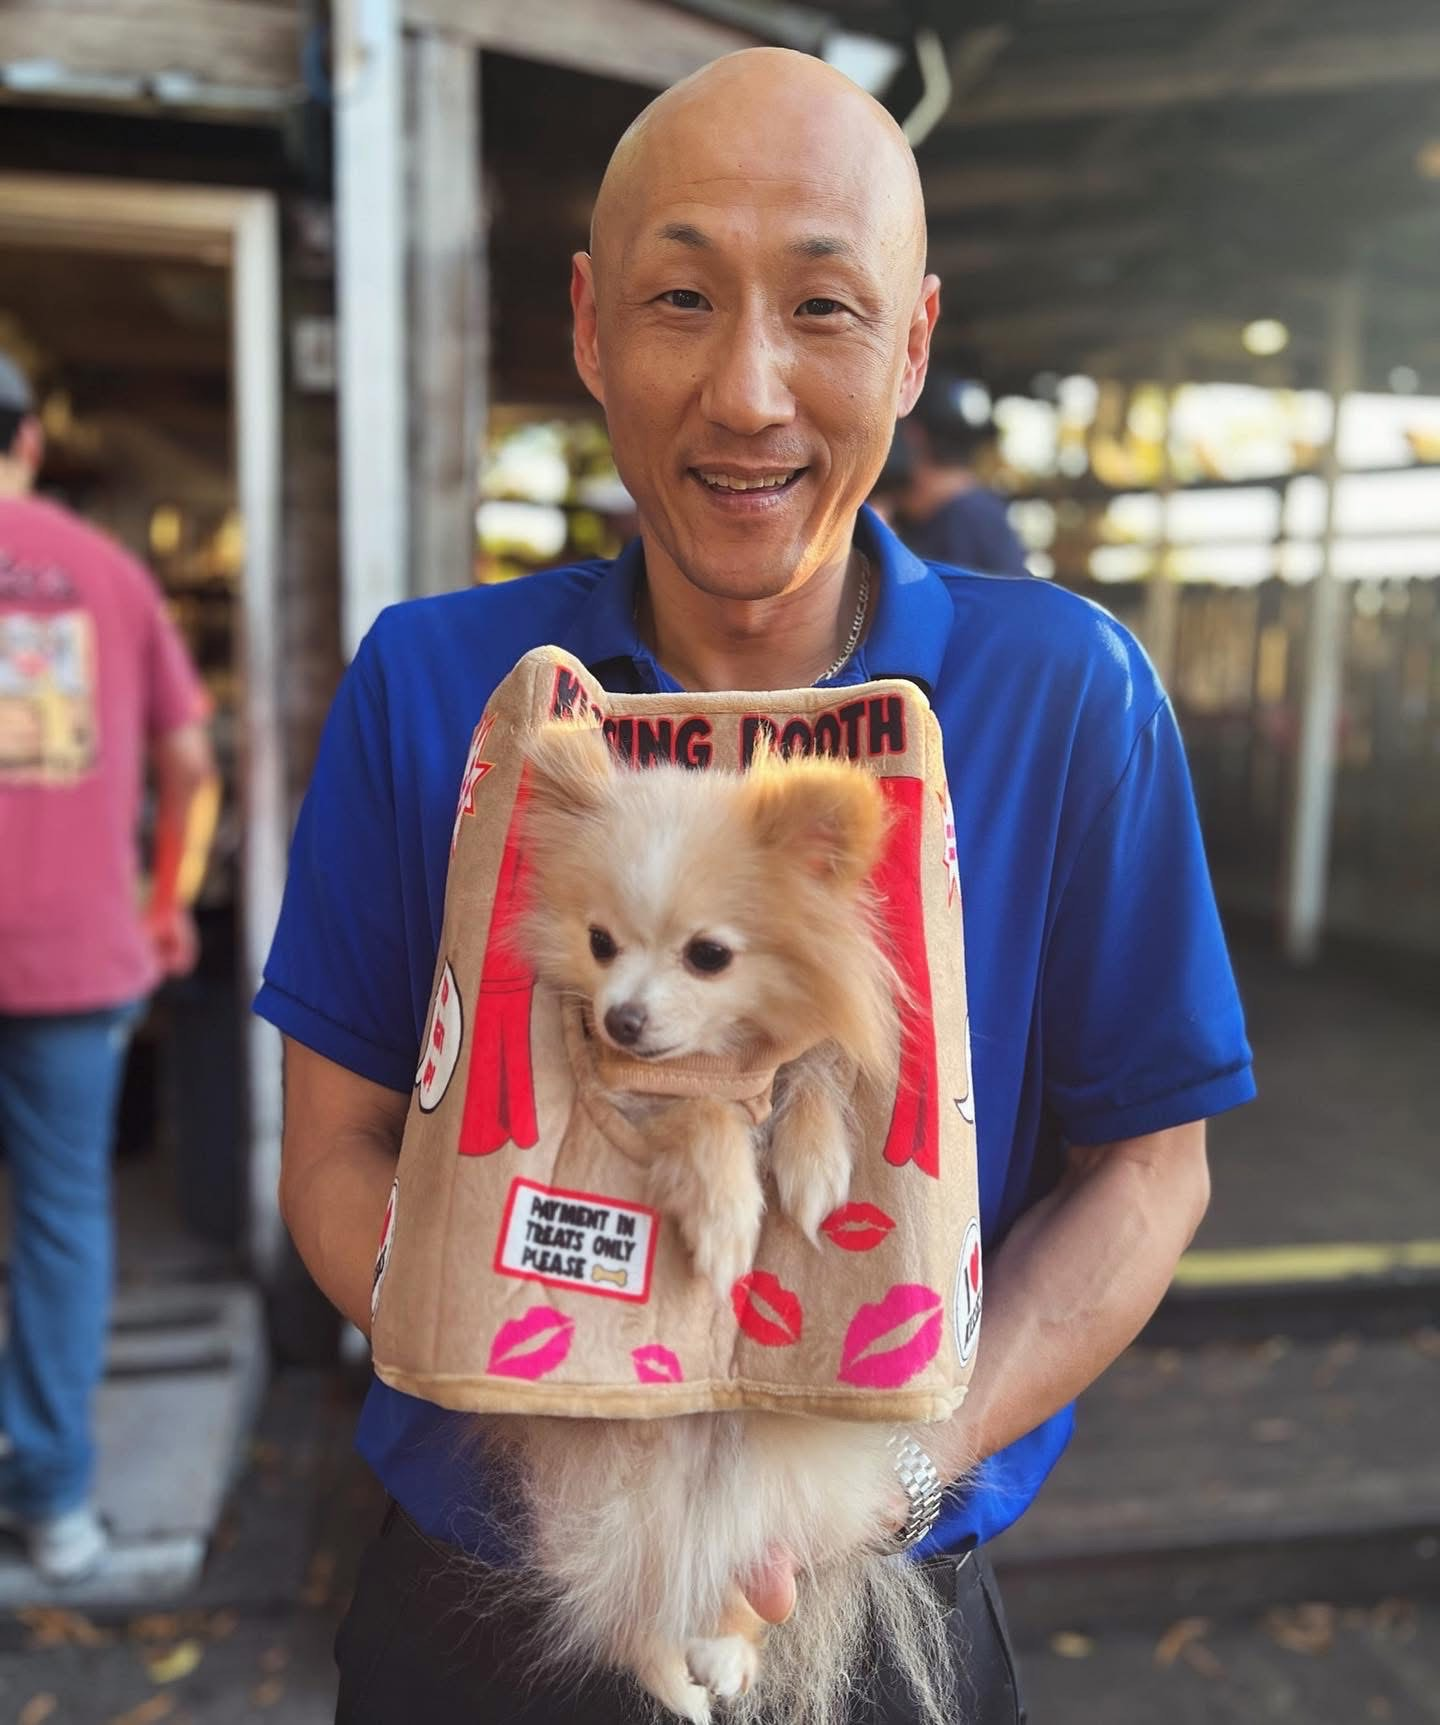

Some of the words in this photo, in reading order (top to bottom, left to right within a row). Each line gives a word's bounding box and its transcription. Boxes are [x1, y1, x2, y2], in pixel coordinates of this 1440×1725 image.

[549, 667, 713, 771] KISING
[530, 1196, 610, 1231] PAYMENT
[616, 1213, 636, 1238] IN
[525, 1220, 585, 1252] TREATS
[592, 1236, 636, 1262] ONLY
[521, 1246, 586, 1280] PLEASE
